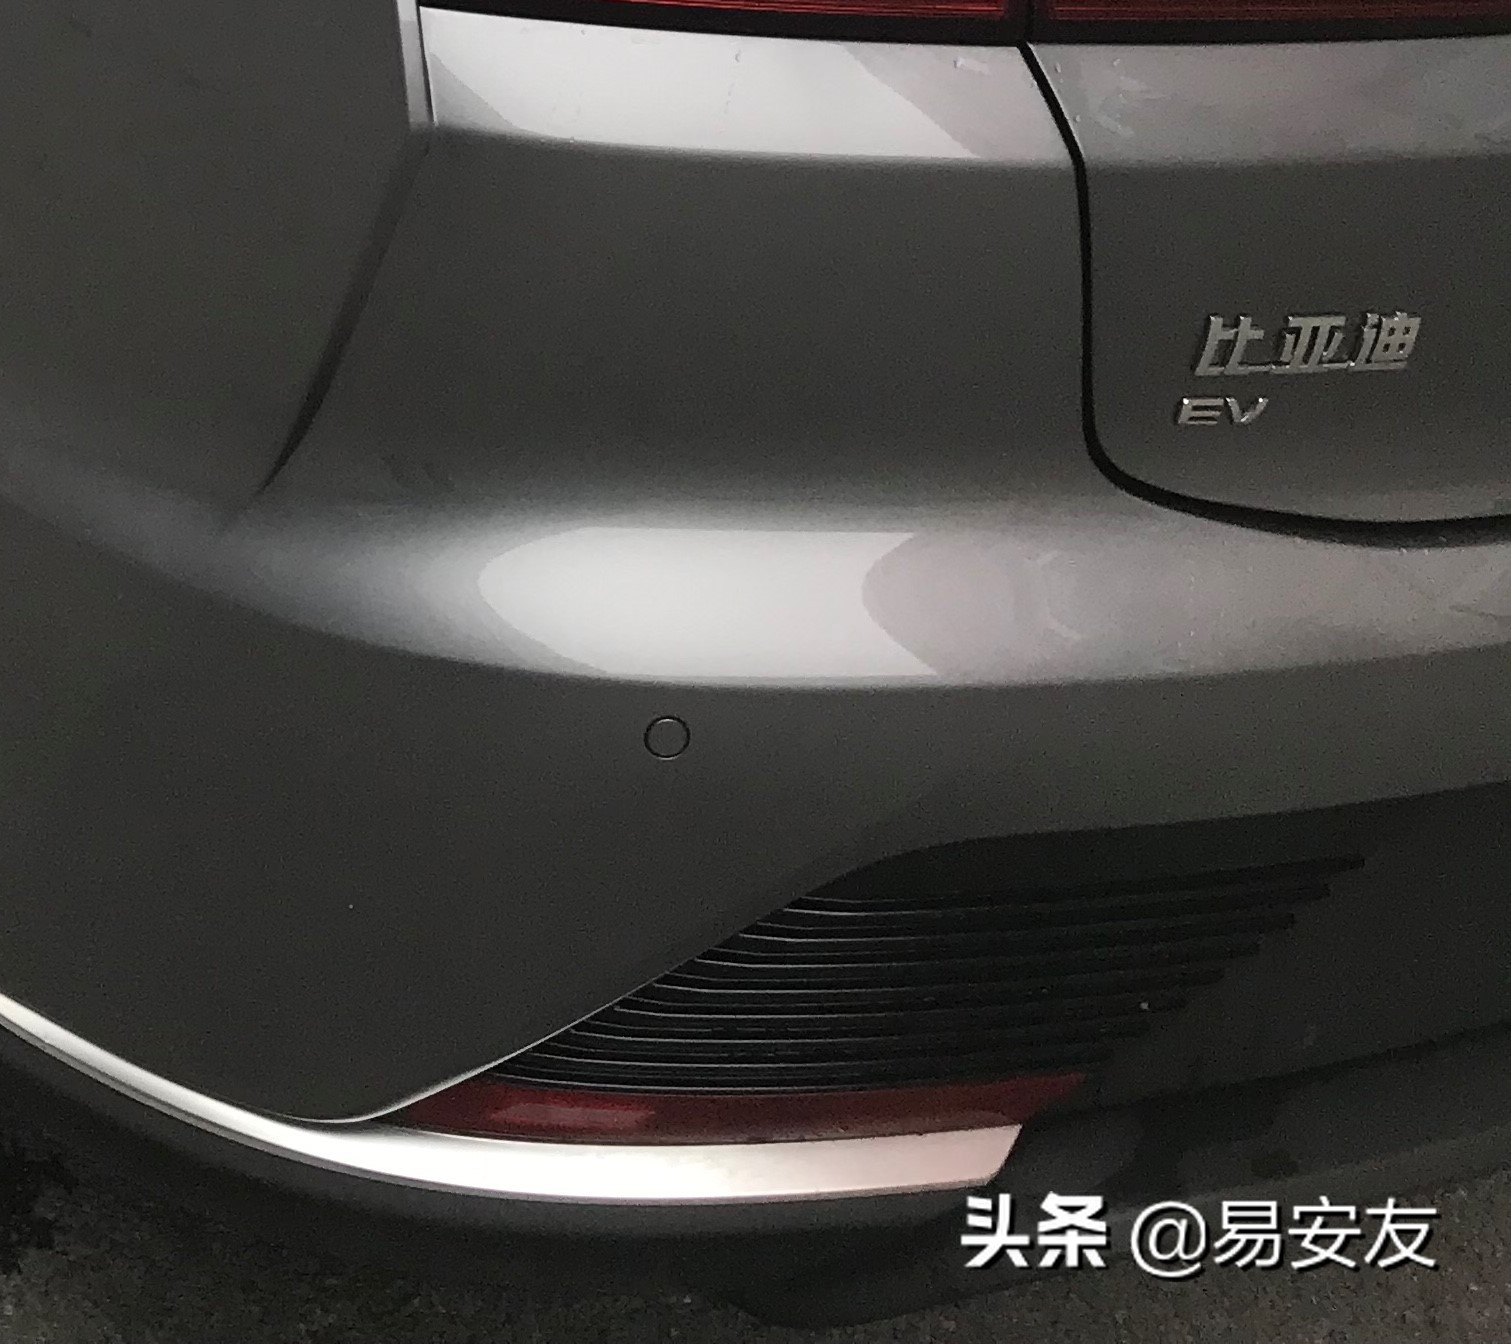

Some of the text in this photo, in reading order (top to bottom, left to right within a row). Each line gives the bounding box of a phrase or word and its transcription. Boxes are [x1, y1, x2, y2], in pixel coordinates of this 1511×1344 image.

[1194, 311, 1422, 376] 比亚迪
[1177, 396, 1269, 425] EV
